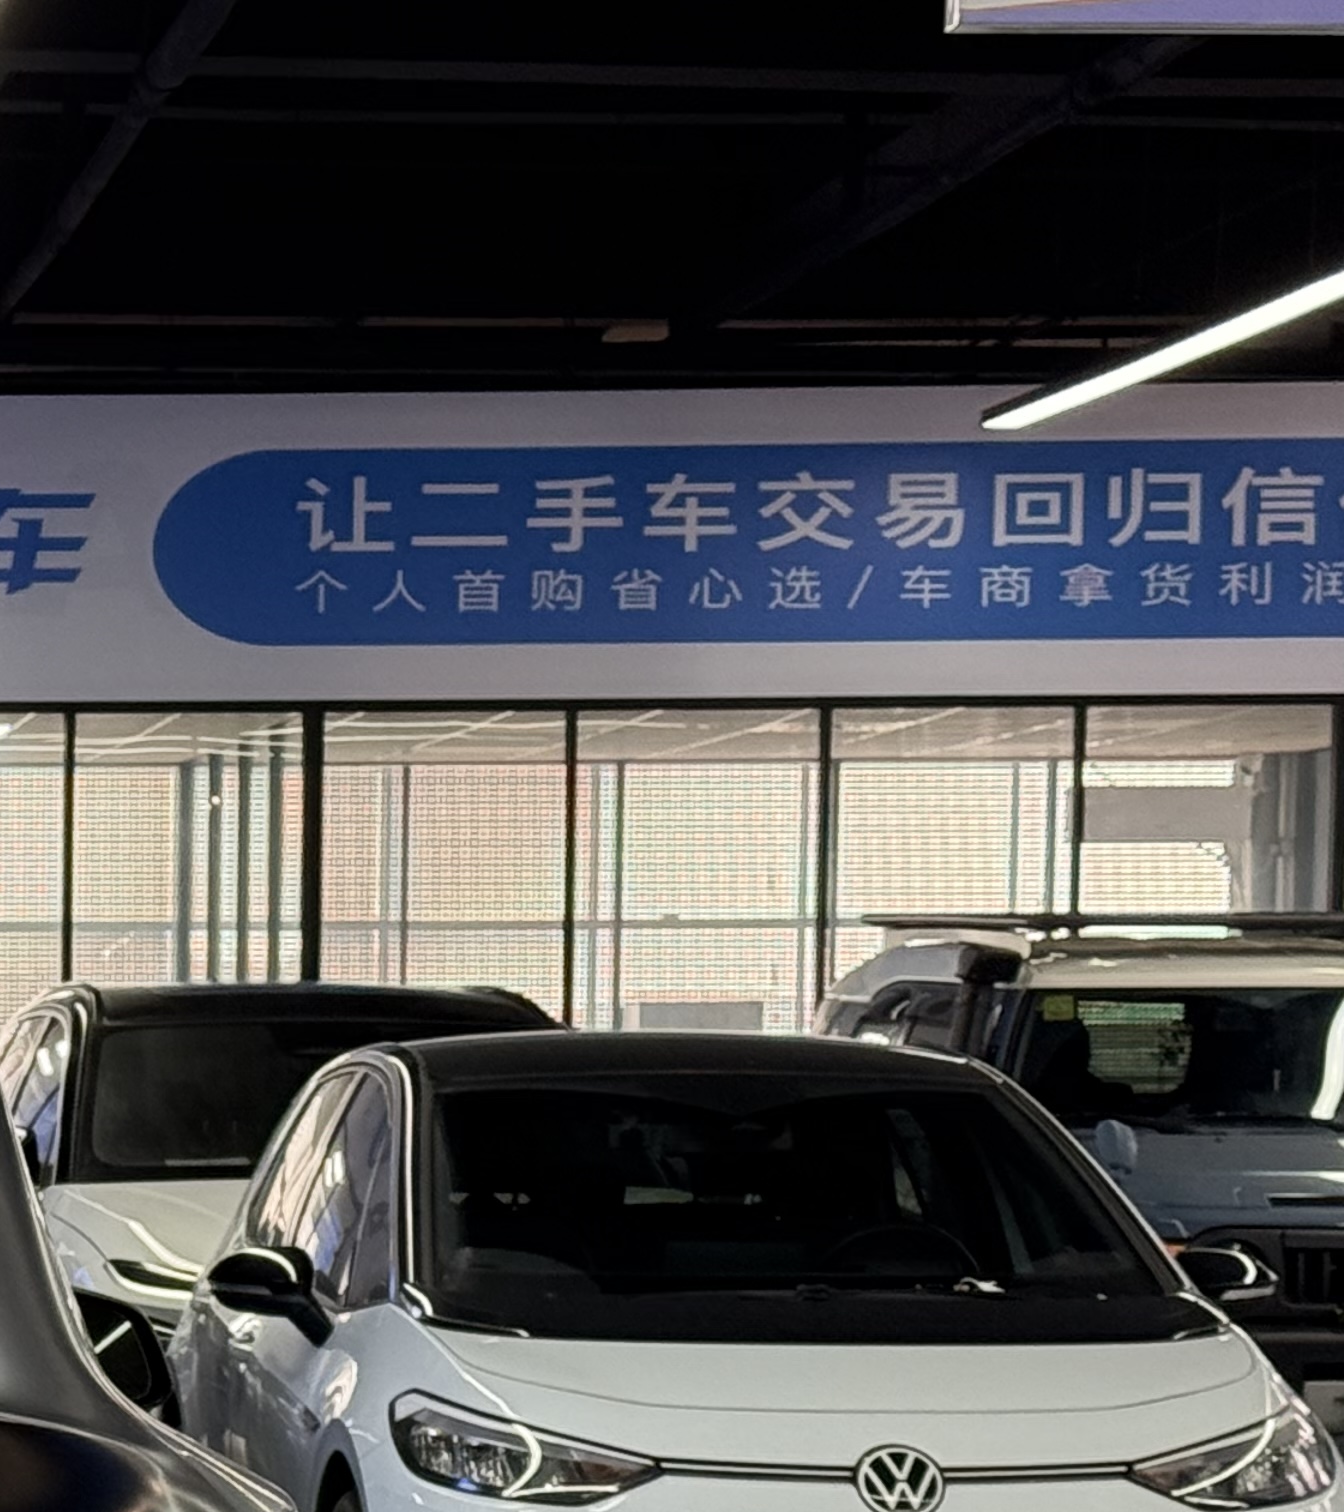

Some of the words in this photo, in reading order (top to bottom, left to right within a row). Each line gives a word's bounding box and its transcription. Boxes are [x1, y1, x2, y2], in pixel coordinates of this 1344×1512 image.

[296, 466, 1344, 552] 让二手车交易回归信
